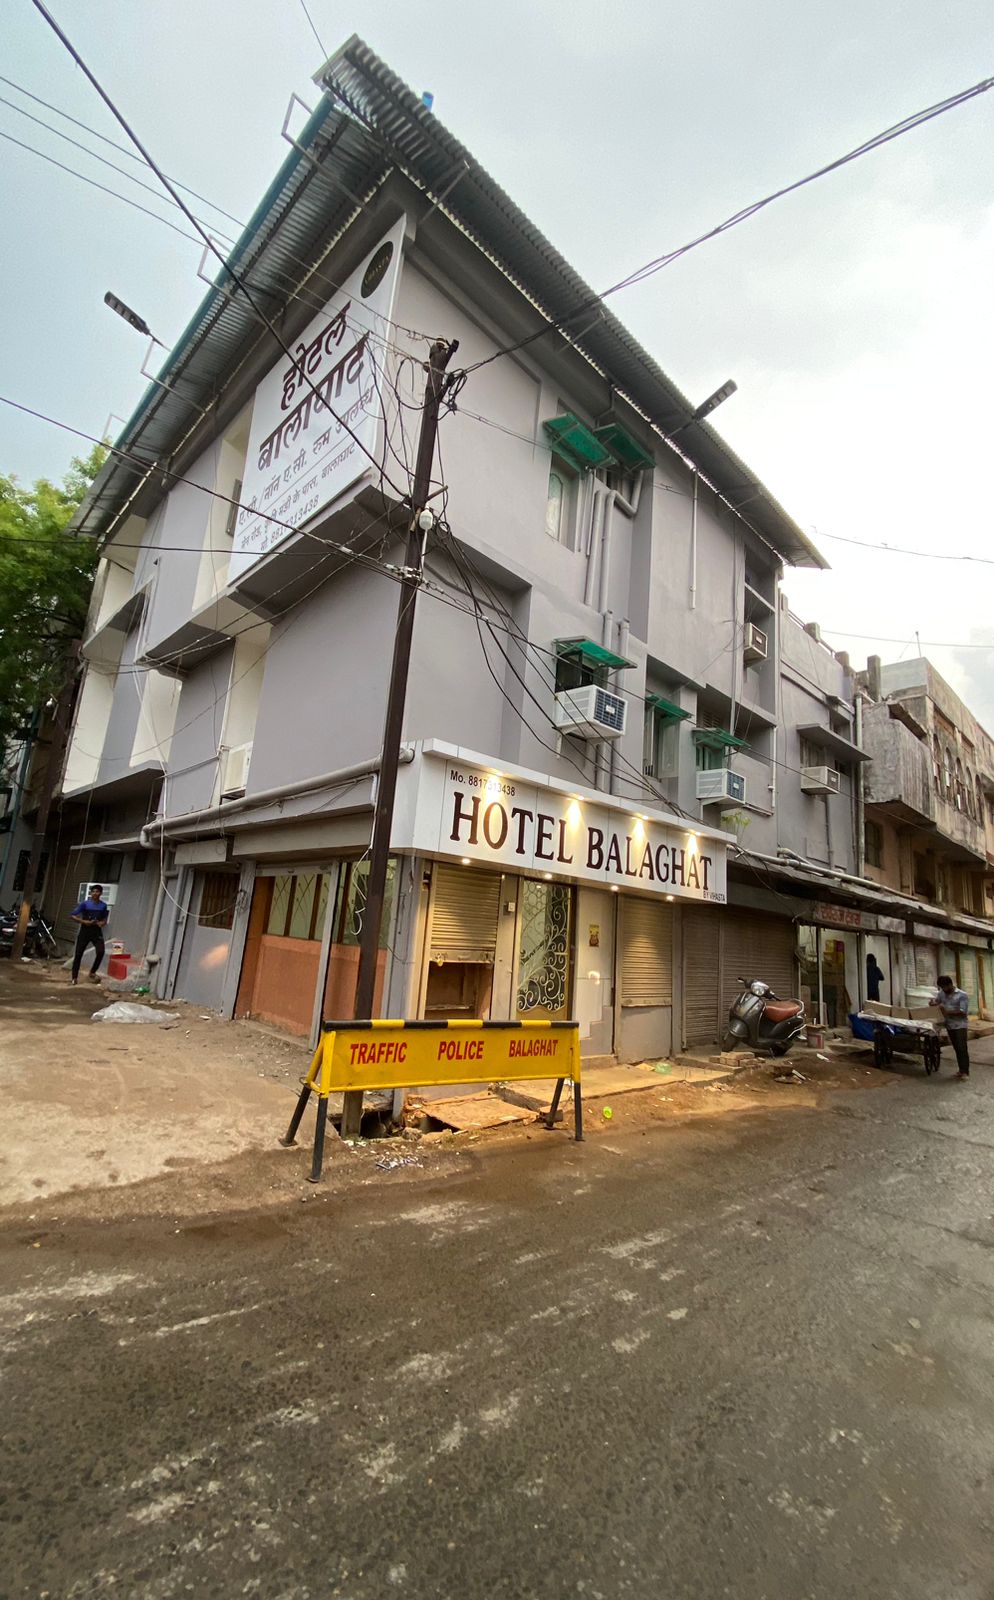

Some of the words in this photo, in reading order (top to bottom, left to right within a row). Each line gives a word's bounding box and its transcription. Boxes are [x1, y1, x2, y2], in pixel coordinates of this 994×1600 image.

[258, 331, 370, 472] बालाघाट
[280, 300, 351, 410] होटल
[450, 769, 466, 784] Mo.
[450, 791, 573, 864] HOTEL
[586, 826, 712, 891] BALAGHAT
[350, 1042, 408, 1065] TRAFFIC
[437, 1041, 484, 1061] POLICE
[508, 1039, 558, 1058] BALAGHAT
